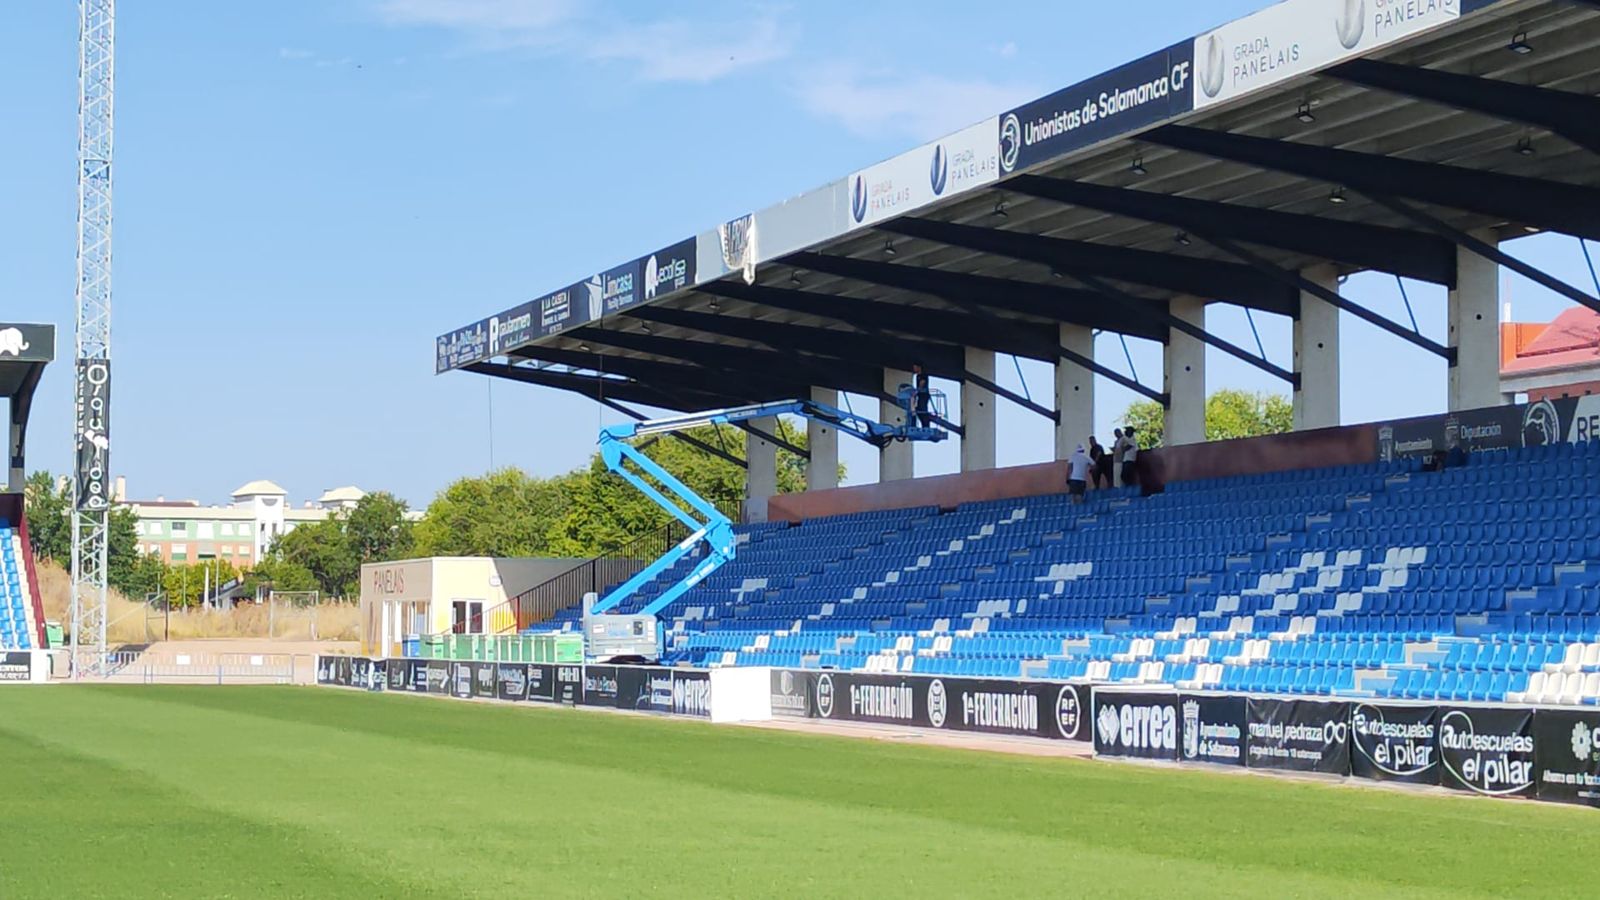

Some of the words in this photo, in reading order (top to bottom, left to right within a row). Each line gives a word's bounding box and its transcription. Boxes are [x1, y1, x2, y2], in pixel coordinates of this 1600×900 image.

[1233, 36, 1269, 62] GRADA
[1233, 44, 1299, 87] PANELAIS
[1025, 108, 1081, 146] Unionistas
[1081, 99, 1098, 125] de
[1098, 76, 1169, 118] Salamanca
[1171, 61, 1189, 91] CF
[951, 156, 996, 189] PANELAIS
[870, 187, 910, 217] PANELAIS
[1460, 421, 1502, 441] Diputación
[1060, 698, 1075, 710] RF
[1060, 714, 1075, 725] EF
[1120, 704, 1176, 749] errea
[1248, 721, 1283, 739] manuel
[1284, 722, 1323, 744] pedraza
[1442, 724, 1534, 753] autoescuelas
[1374, 738, 1390, 764] el
[1394, 739, 1433, 771] pilar
[1462, 752, 1480, 782] el
[1484, 753, 1533, 790] pilar
